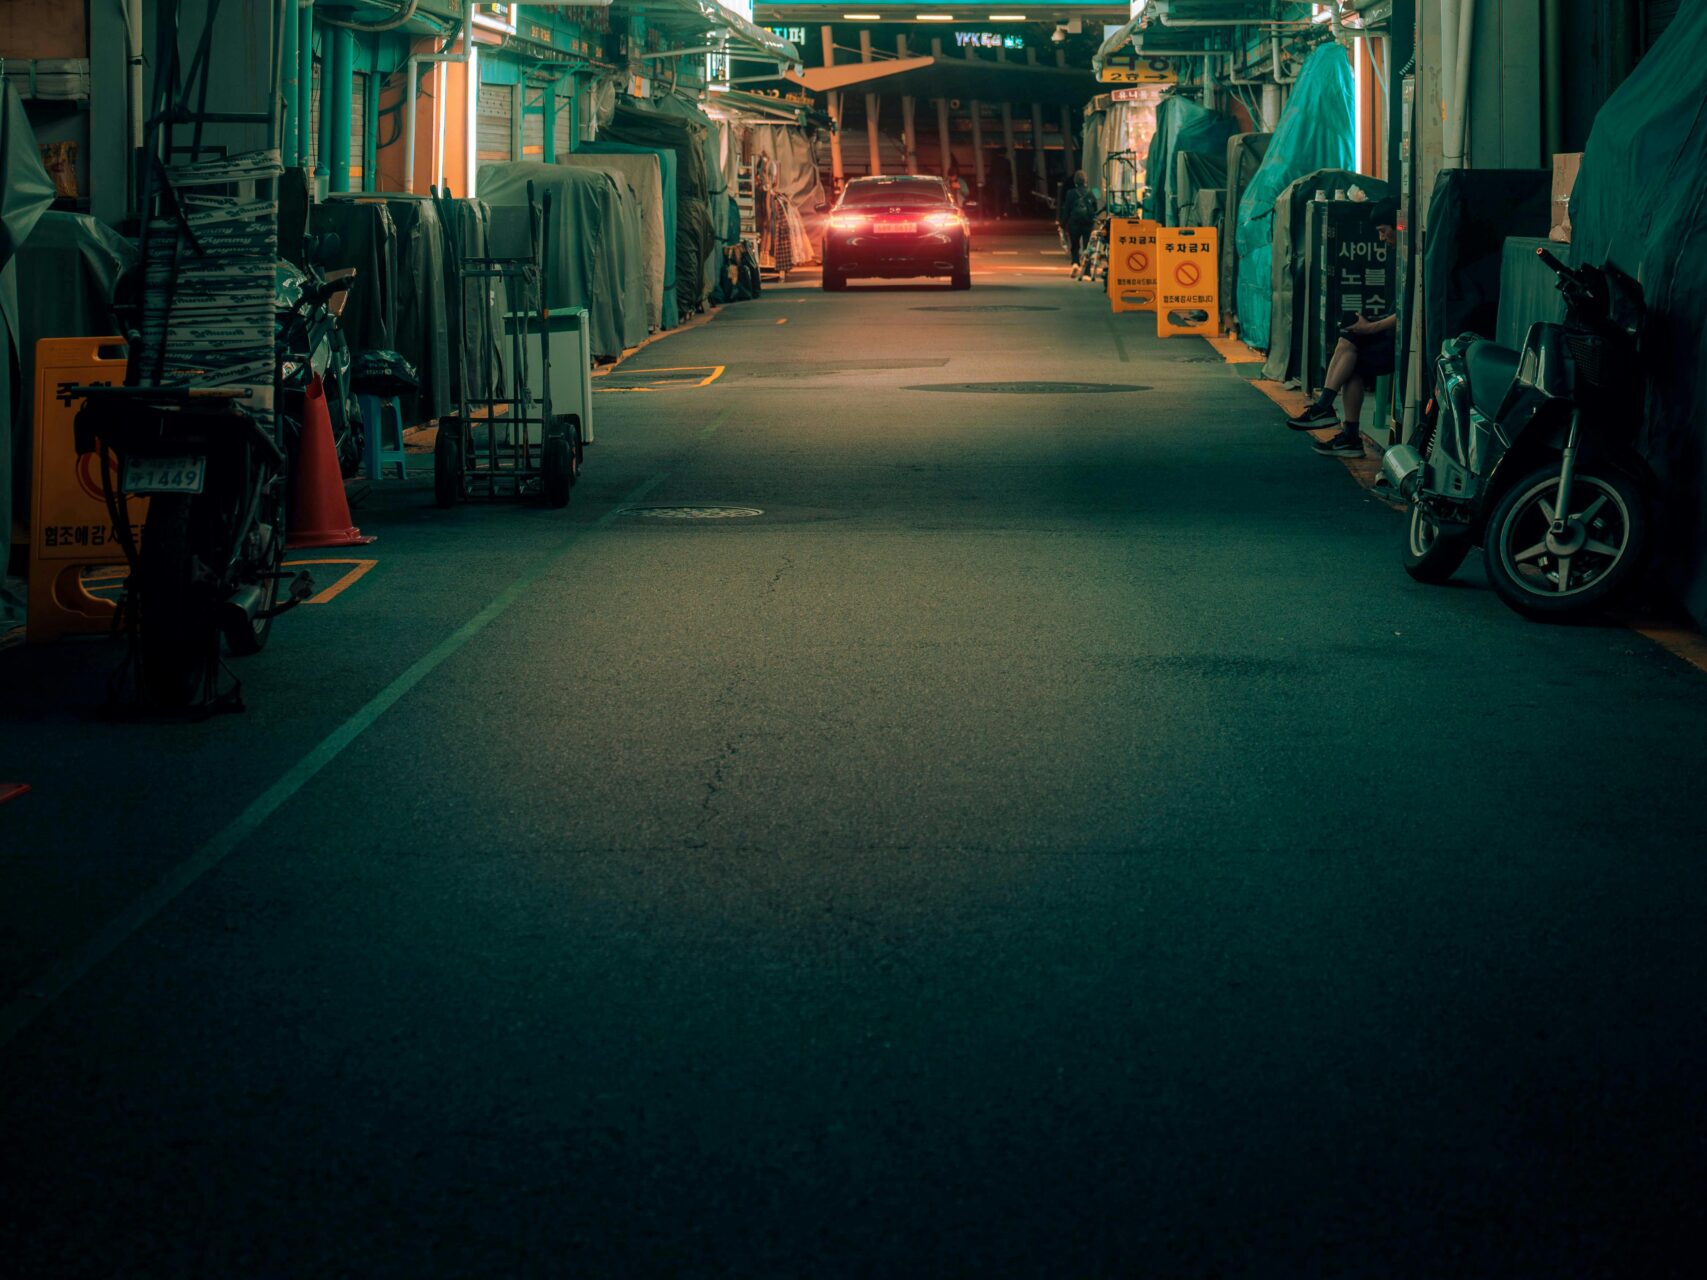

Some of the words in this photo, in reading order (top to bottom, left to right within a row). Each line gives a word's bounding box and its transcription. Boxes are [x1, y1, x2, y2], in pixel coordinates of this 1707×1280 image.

[1165, 242, 1210, 254] 주차금지
[1338, 241, 1388, 263] 샤이닝
[1340, 267, 1386, 287] 노블
[1340, 293, 1386, 316] 특수
